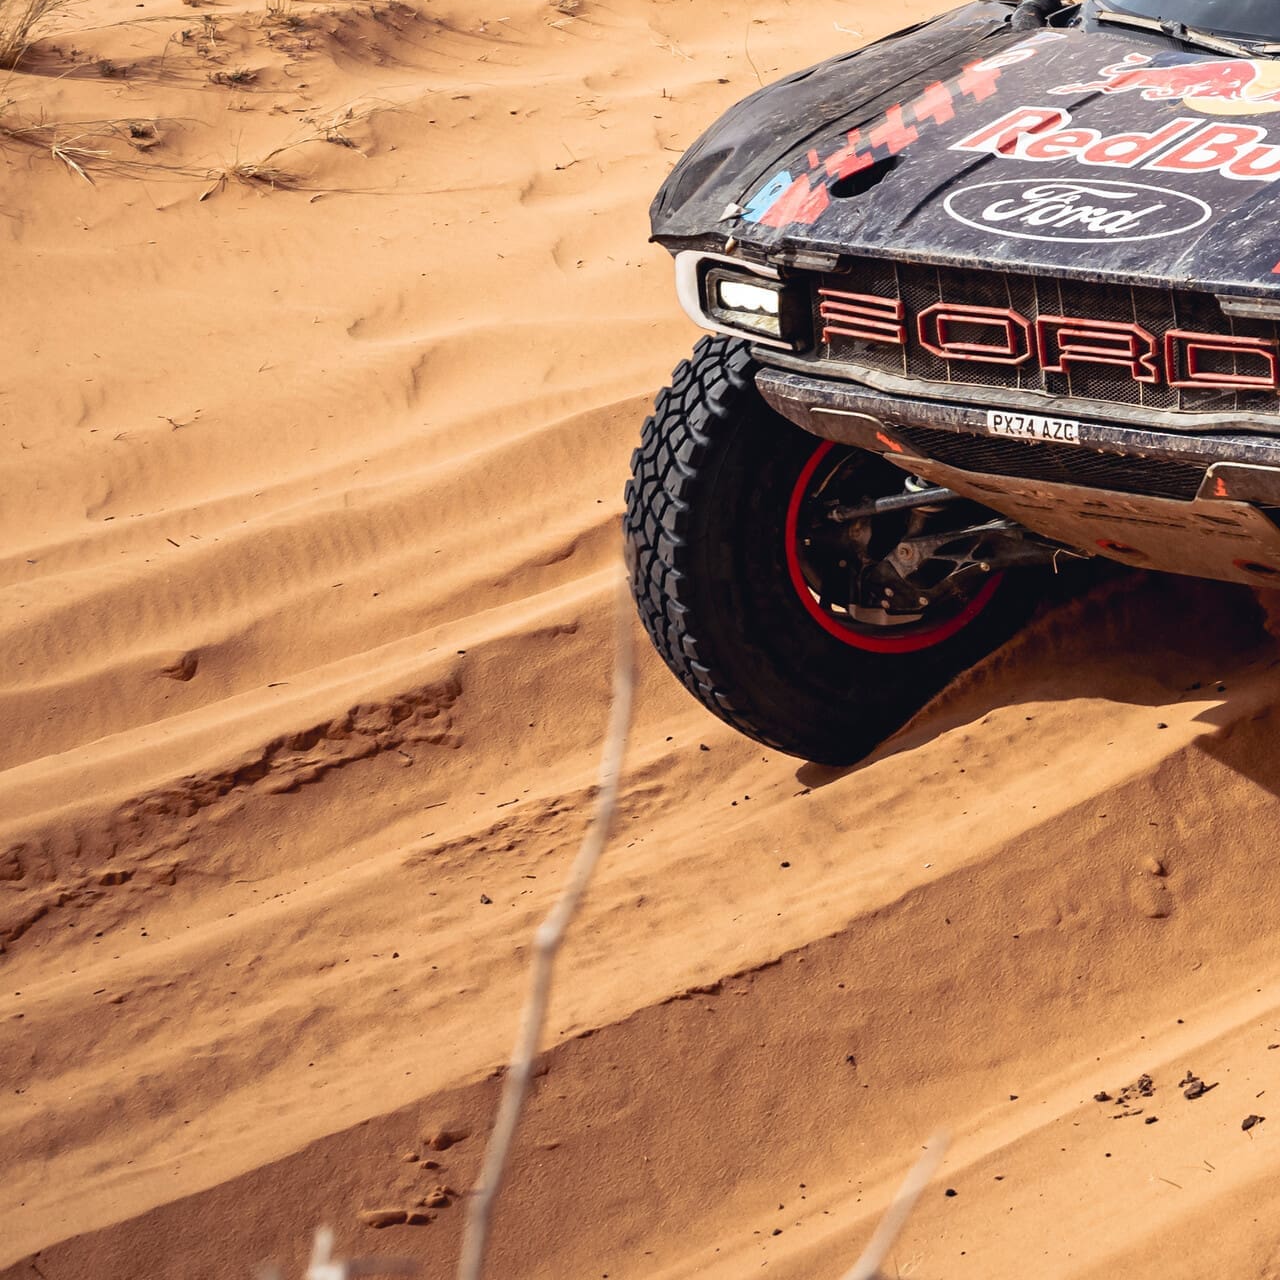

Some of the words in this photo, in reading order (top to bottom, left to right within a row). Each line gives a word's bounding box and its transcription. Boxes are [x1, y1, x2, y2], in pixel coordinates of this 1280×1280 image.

[947, 105, 1207, 169] Red
[982, 183, 1167, 234] Ford
[818, 287, 1279, 389] FORD
[993, 414, 1036, 438] PX74
